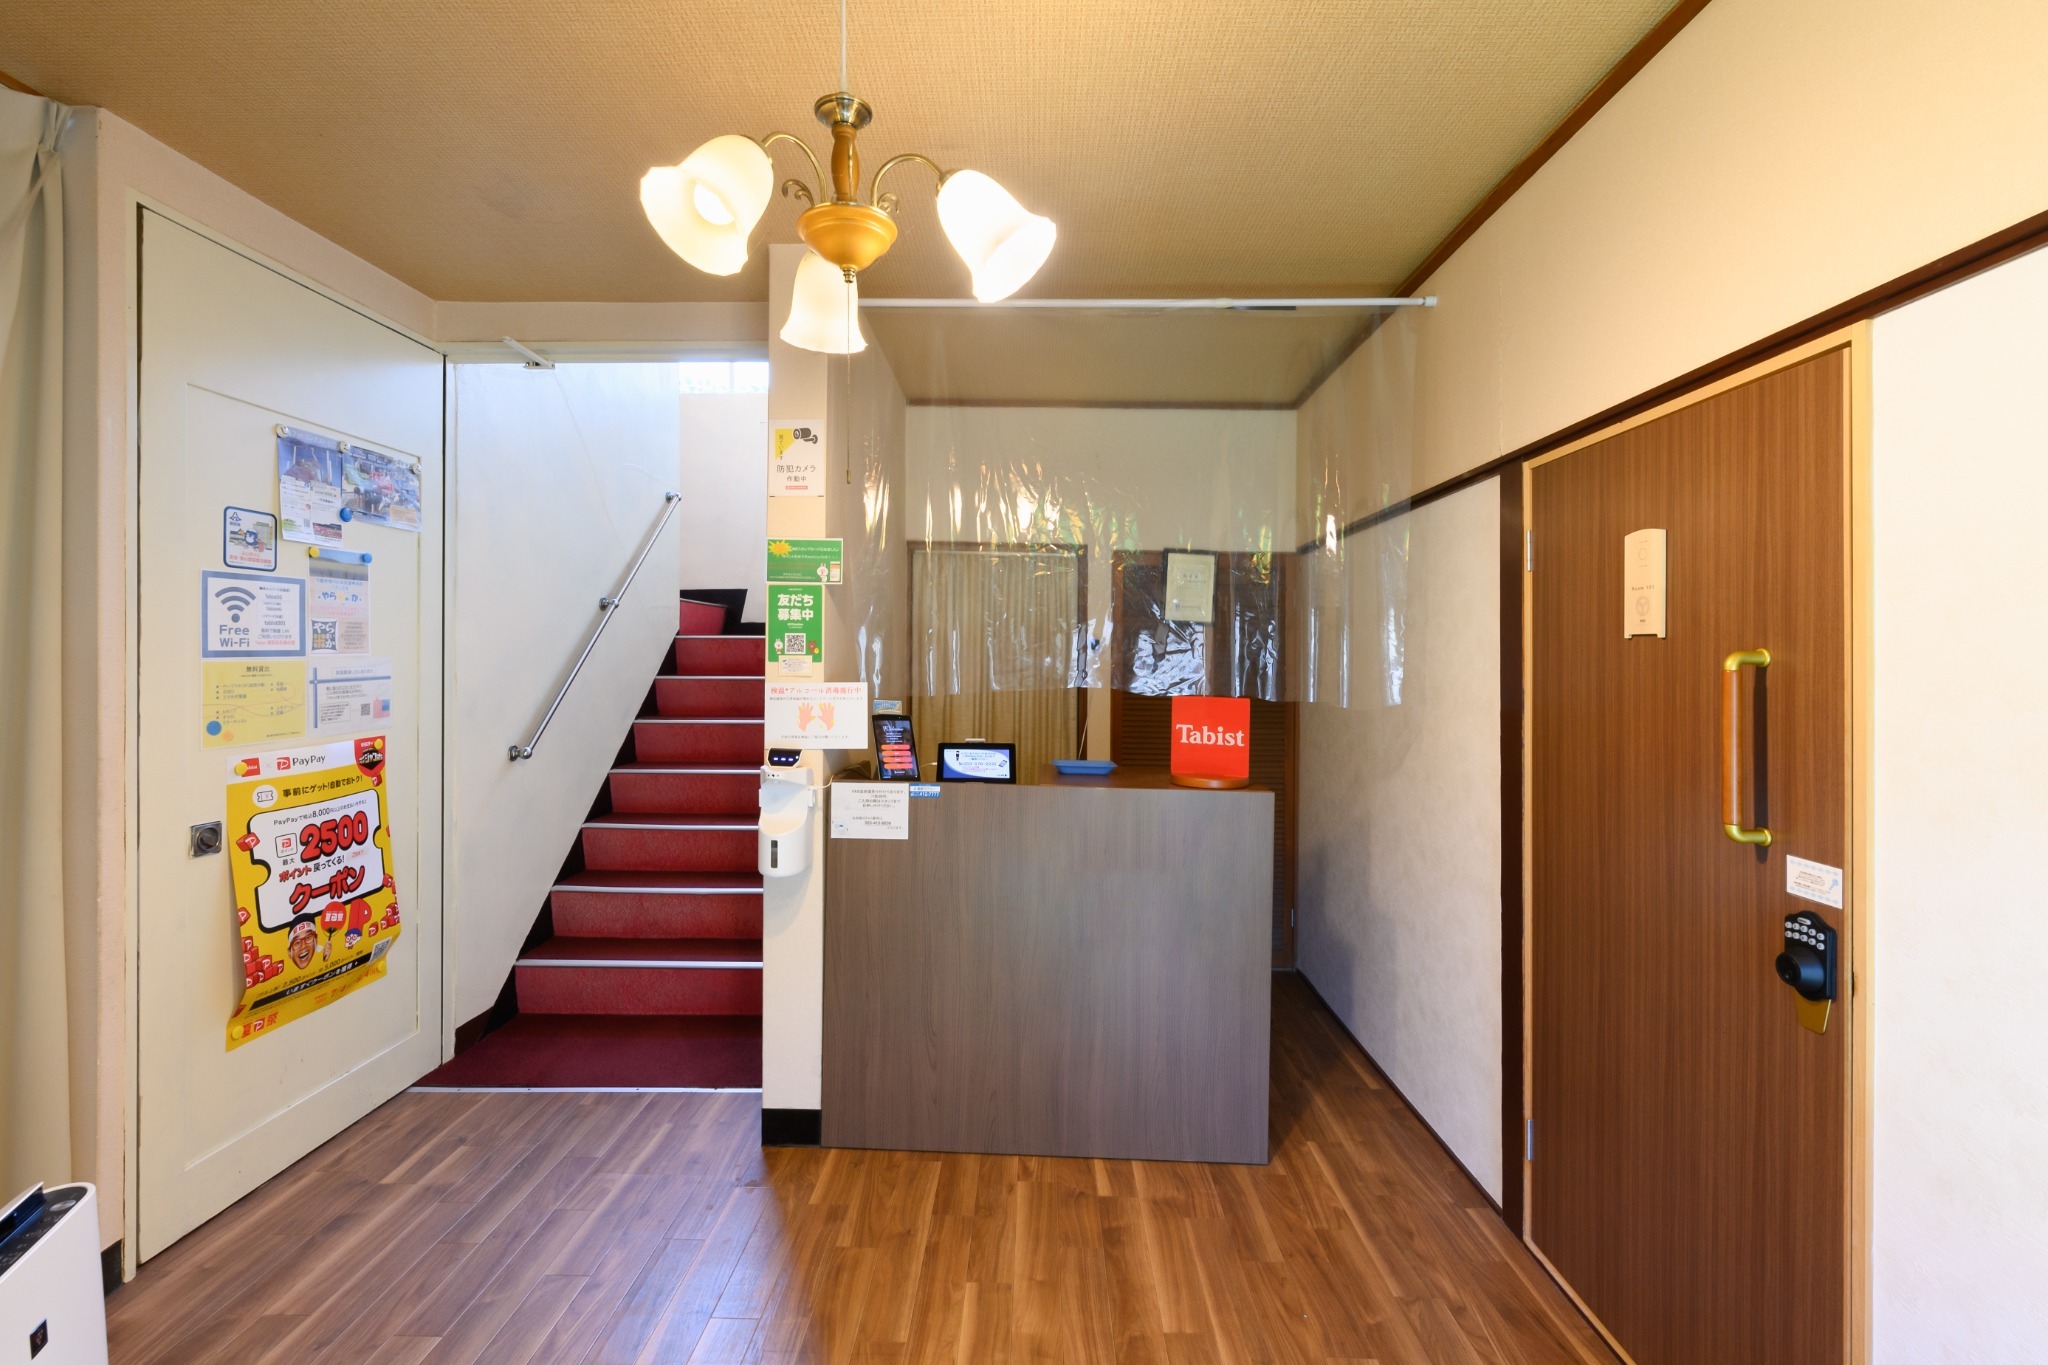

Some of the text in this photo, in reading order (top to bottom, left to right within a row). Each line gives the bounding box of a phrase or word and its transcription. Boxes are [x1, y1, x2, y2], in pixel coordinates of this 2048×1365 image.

[776, 464, 816, 474] 防犯カメラ
[778, 594, 814, 607] 友だち
[778, 608, 814, 621] 募集中
[219, 625, 250, 636] Free
[219, 638, 250, 648] Wi-Fi
[1176, 724, 1245, 747] Tabist
[292, 755, 326, 766] PayPay
[300, 810, 368, 864] 2500
[282, 858, 295, 866] 最大
[289, 866, 365, 914] クーポン
